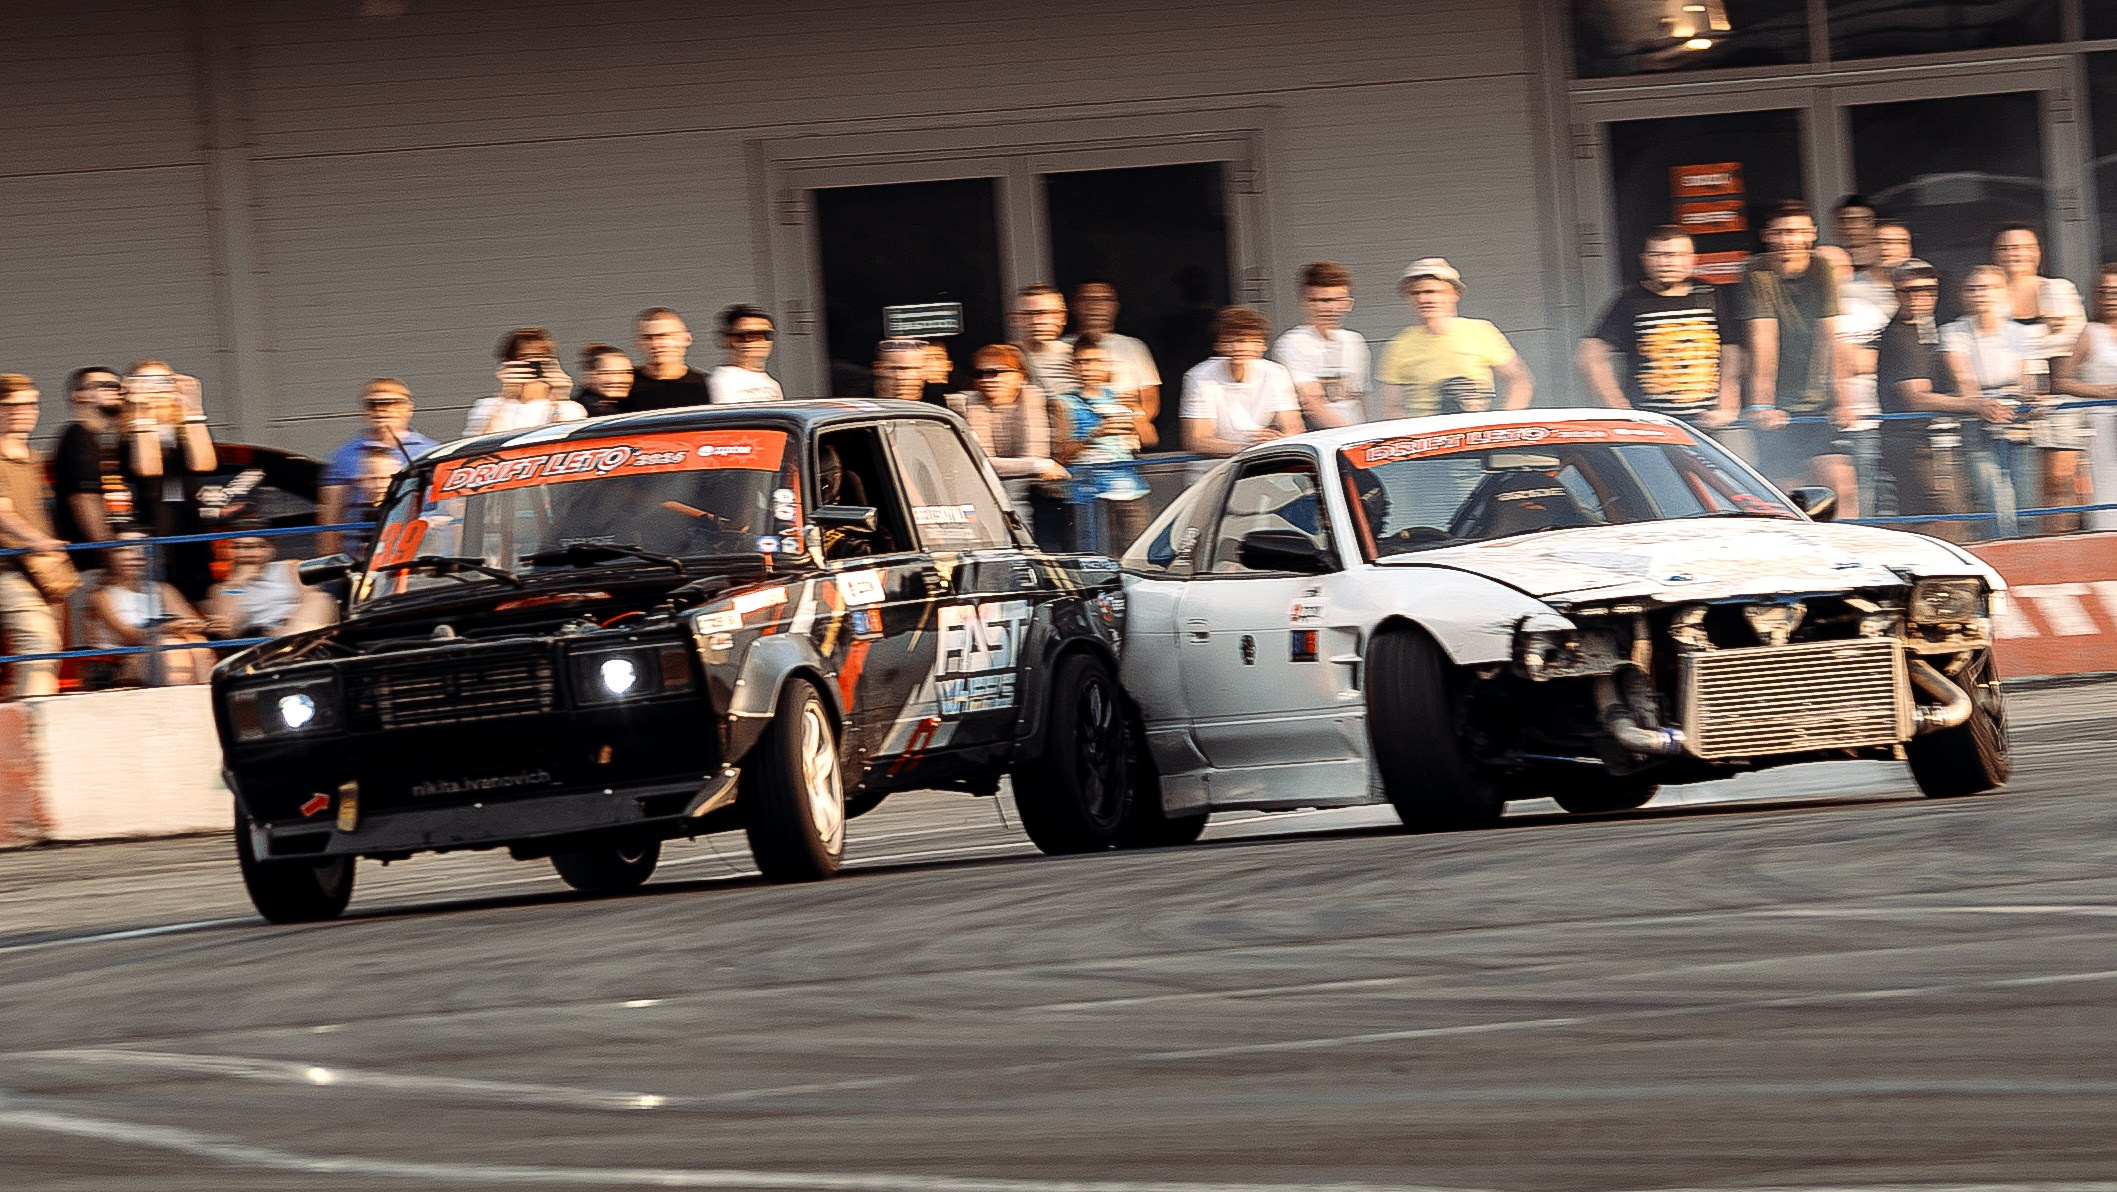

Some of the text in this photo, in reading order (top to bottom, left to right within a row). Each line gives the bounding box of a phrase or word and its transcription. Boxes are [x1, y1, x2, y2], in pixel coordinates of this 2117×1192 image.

[1366, 426, 1550, 462] DRIFT LETO
[442, 455, 549, 491] DRIFT
[541, 446, 631, 475] LETO
[935, 600, 1035, 676] FAST
